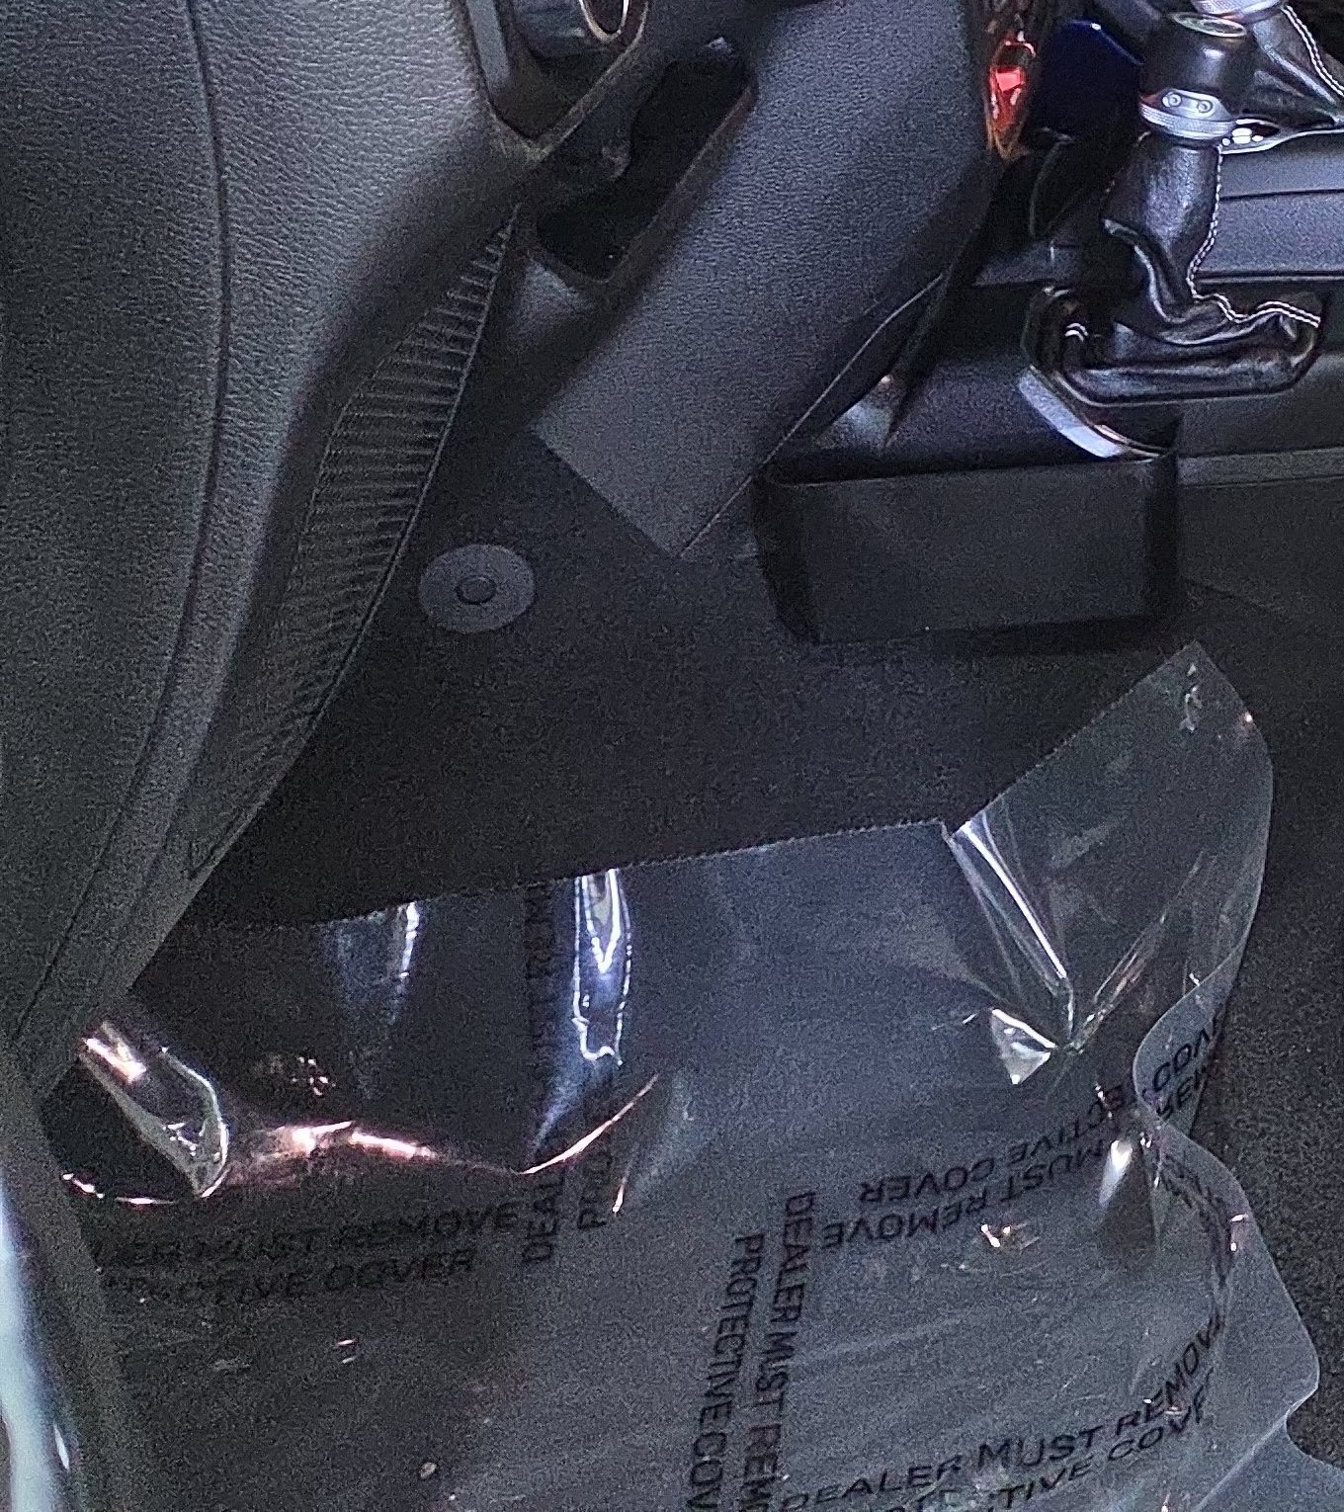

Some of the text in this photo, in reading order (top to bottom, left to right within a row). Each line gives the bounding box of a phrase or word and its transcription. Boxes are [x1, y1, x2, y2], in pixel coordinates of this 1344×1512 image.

[860, 1157, 994, 1205] COVER
[332, 1201, 519, 1251] REMOVE
[821, 1188, 987, 1250] REMOVE
[325, 1248, 478, 1293] COVER
[771, 1193, 816, 1323] DEALER
[699, 1234, 765, 1424] PROTECTIVE
[756, 1331, 798, 1416] MUST
[781, 1455, 963, 1512] DEALER
[978, 1425, 1103, 1470] MUST
